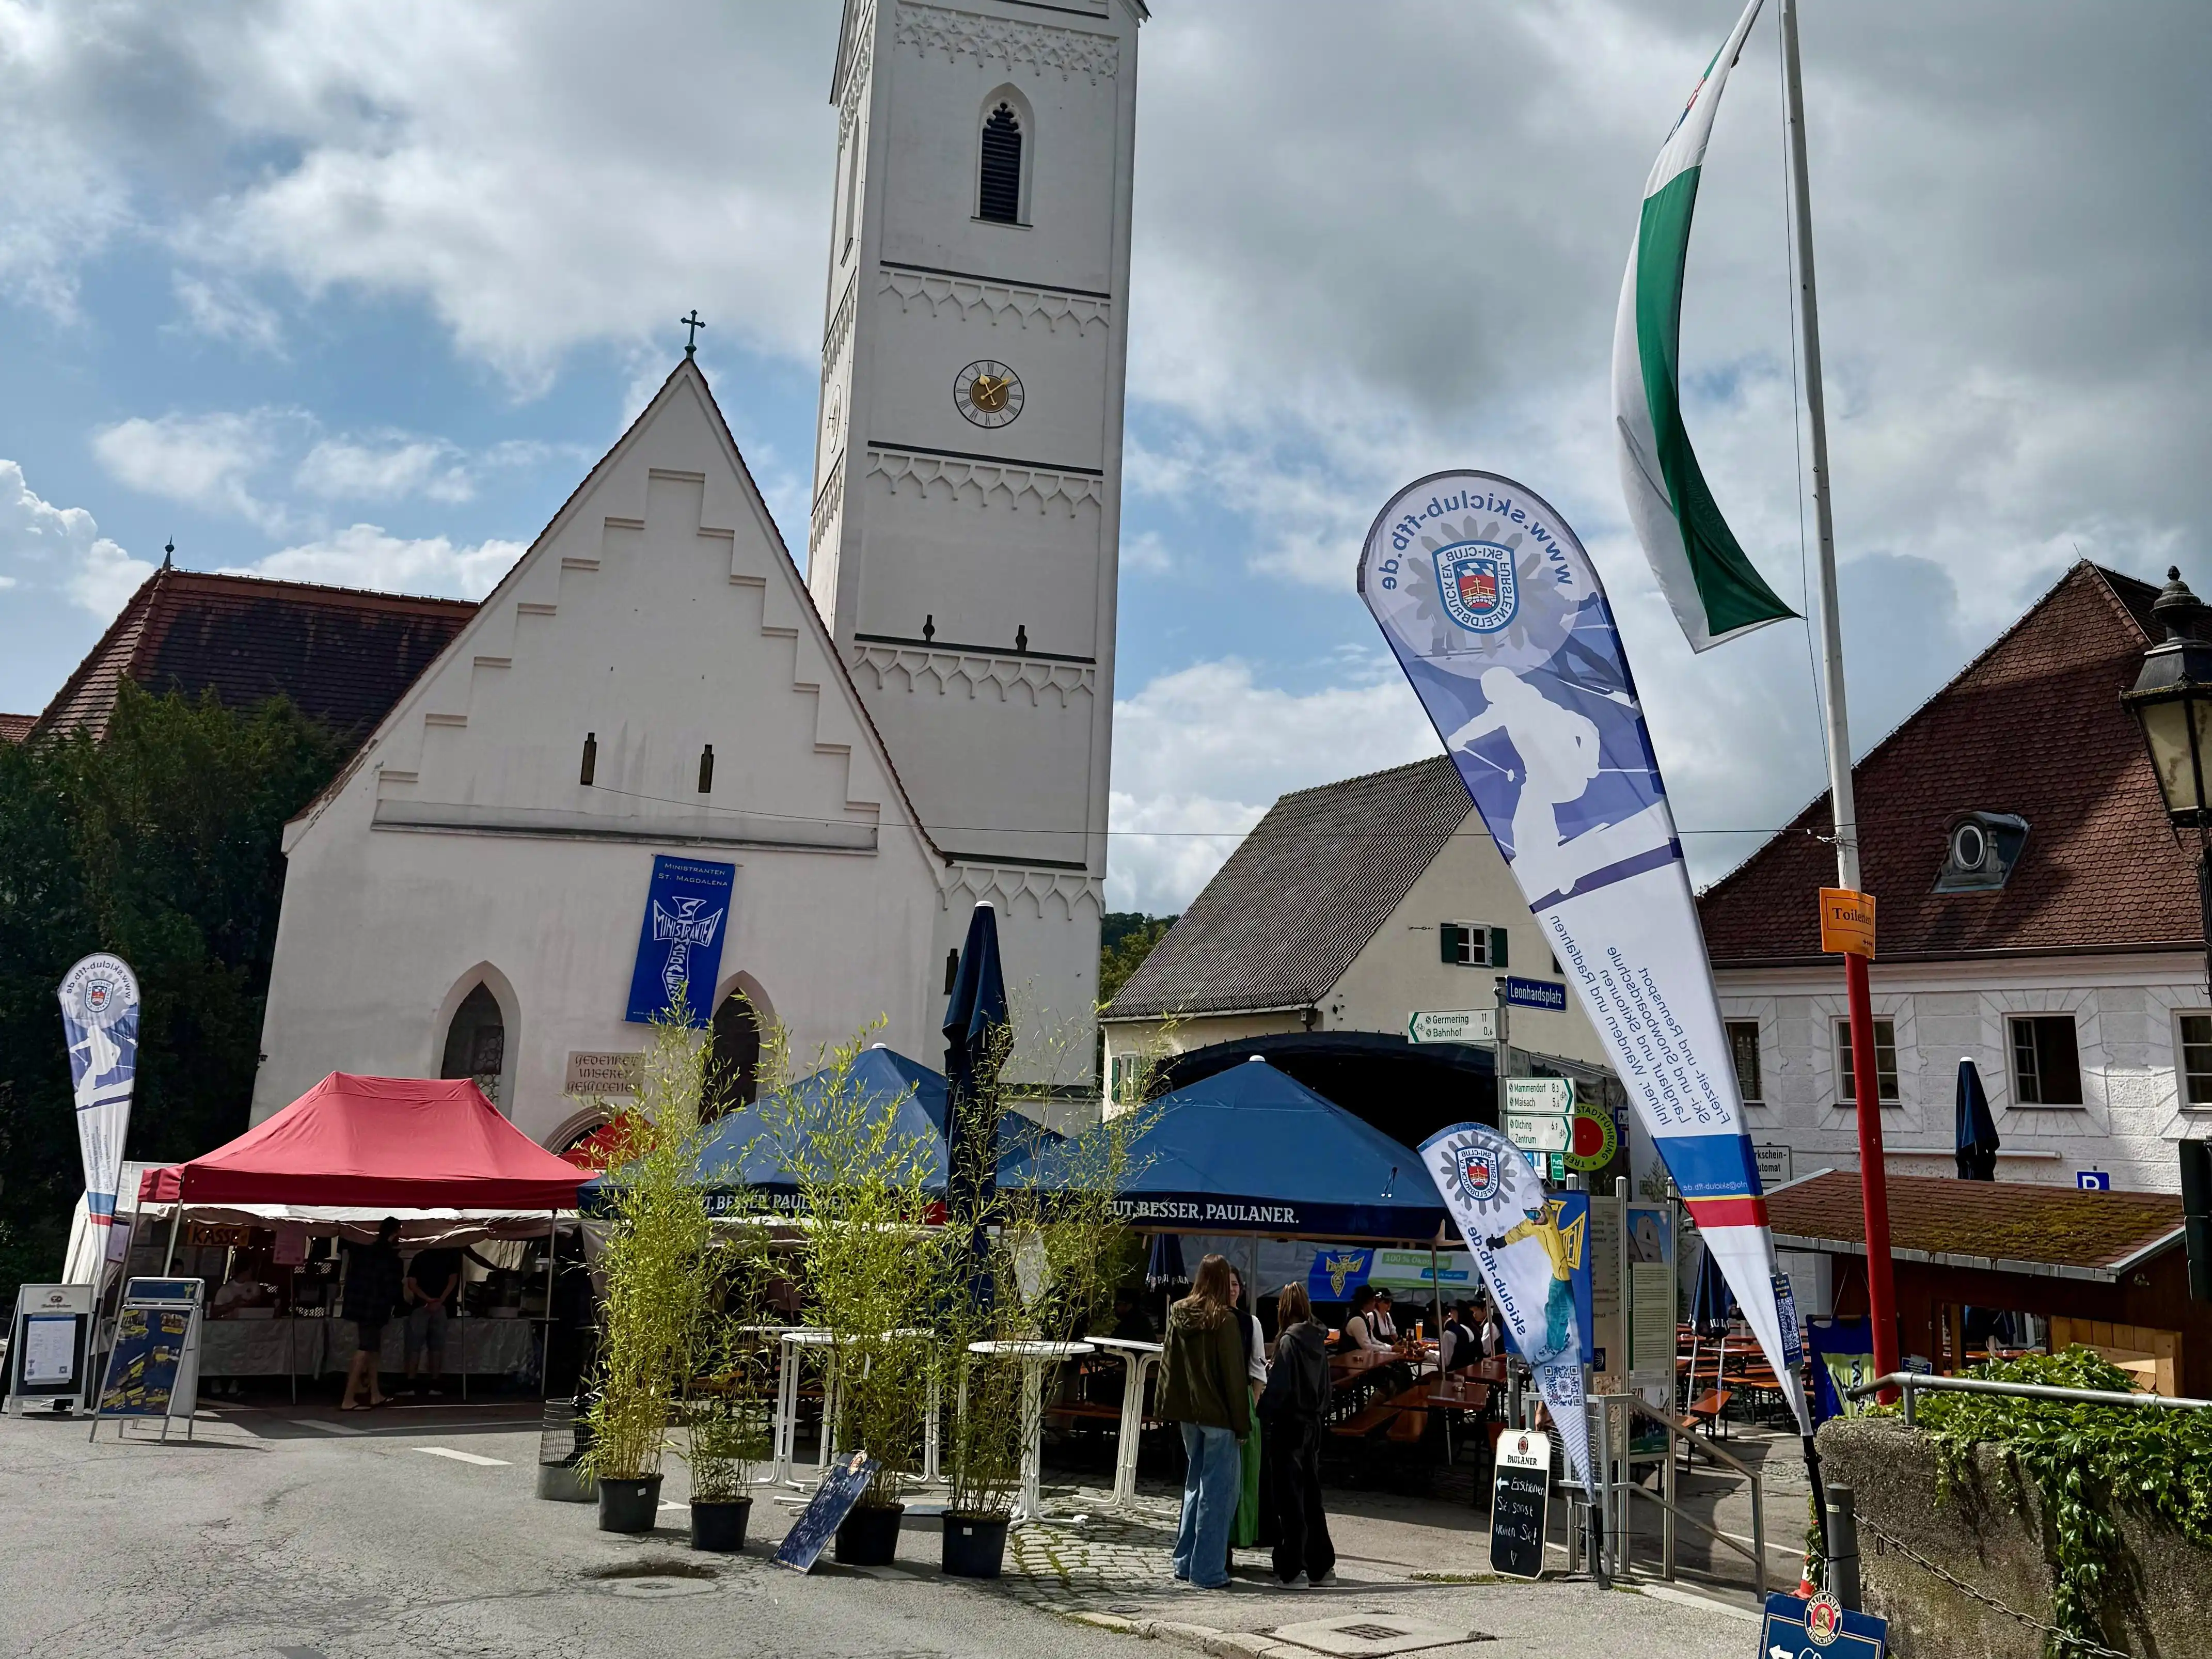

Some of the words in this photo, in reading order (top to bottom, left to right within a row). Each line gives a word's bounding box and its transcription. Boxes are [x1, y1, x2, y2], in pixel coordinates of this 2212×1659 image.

[665, 863, 725, 875] MINISTRANTEN
[676, 875, 727, 886] MAGDALENA
[1832, 908, 1871, 925] Toiletten
[1510, 983, 1561, 1006] Leonhardsplatz
[1433, 1015, 1469, 1025] Germering
[1482, 1014, 1487, 1022] 11
[1433, 1028, 1461, 1037] Bahnhof
[567, 1081, 641, 1093] GEFALLENE
[1514, 1083, 1546, 1093] Mammendorf
[1514, 1097, 1536, 1107] Maisach
[1515, 1119, 1531, 1131] Olching
[1515, 1133, 1536, 1144] Zentrum
[1753, 1148, 1787, 1159] rkschein-
[1757, 1162, 1781, 1172] utomat
[1139, 1202, 1204, 1222] BESSER,
[1206, 1204, 1299, 1223] PAULANER.
[193, 1226, 243, 1245] KASSE
[1507, 1455, 1537, 1466] PAULANER
[1808, 1595, 1840, 1618] PAULANER
[1808, 1626, 1836, 1644] MÜNCHEN
